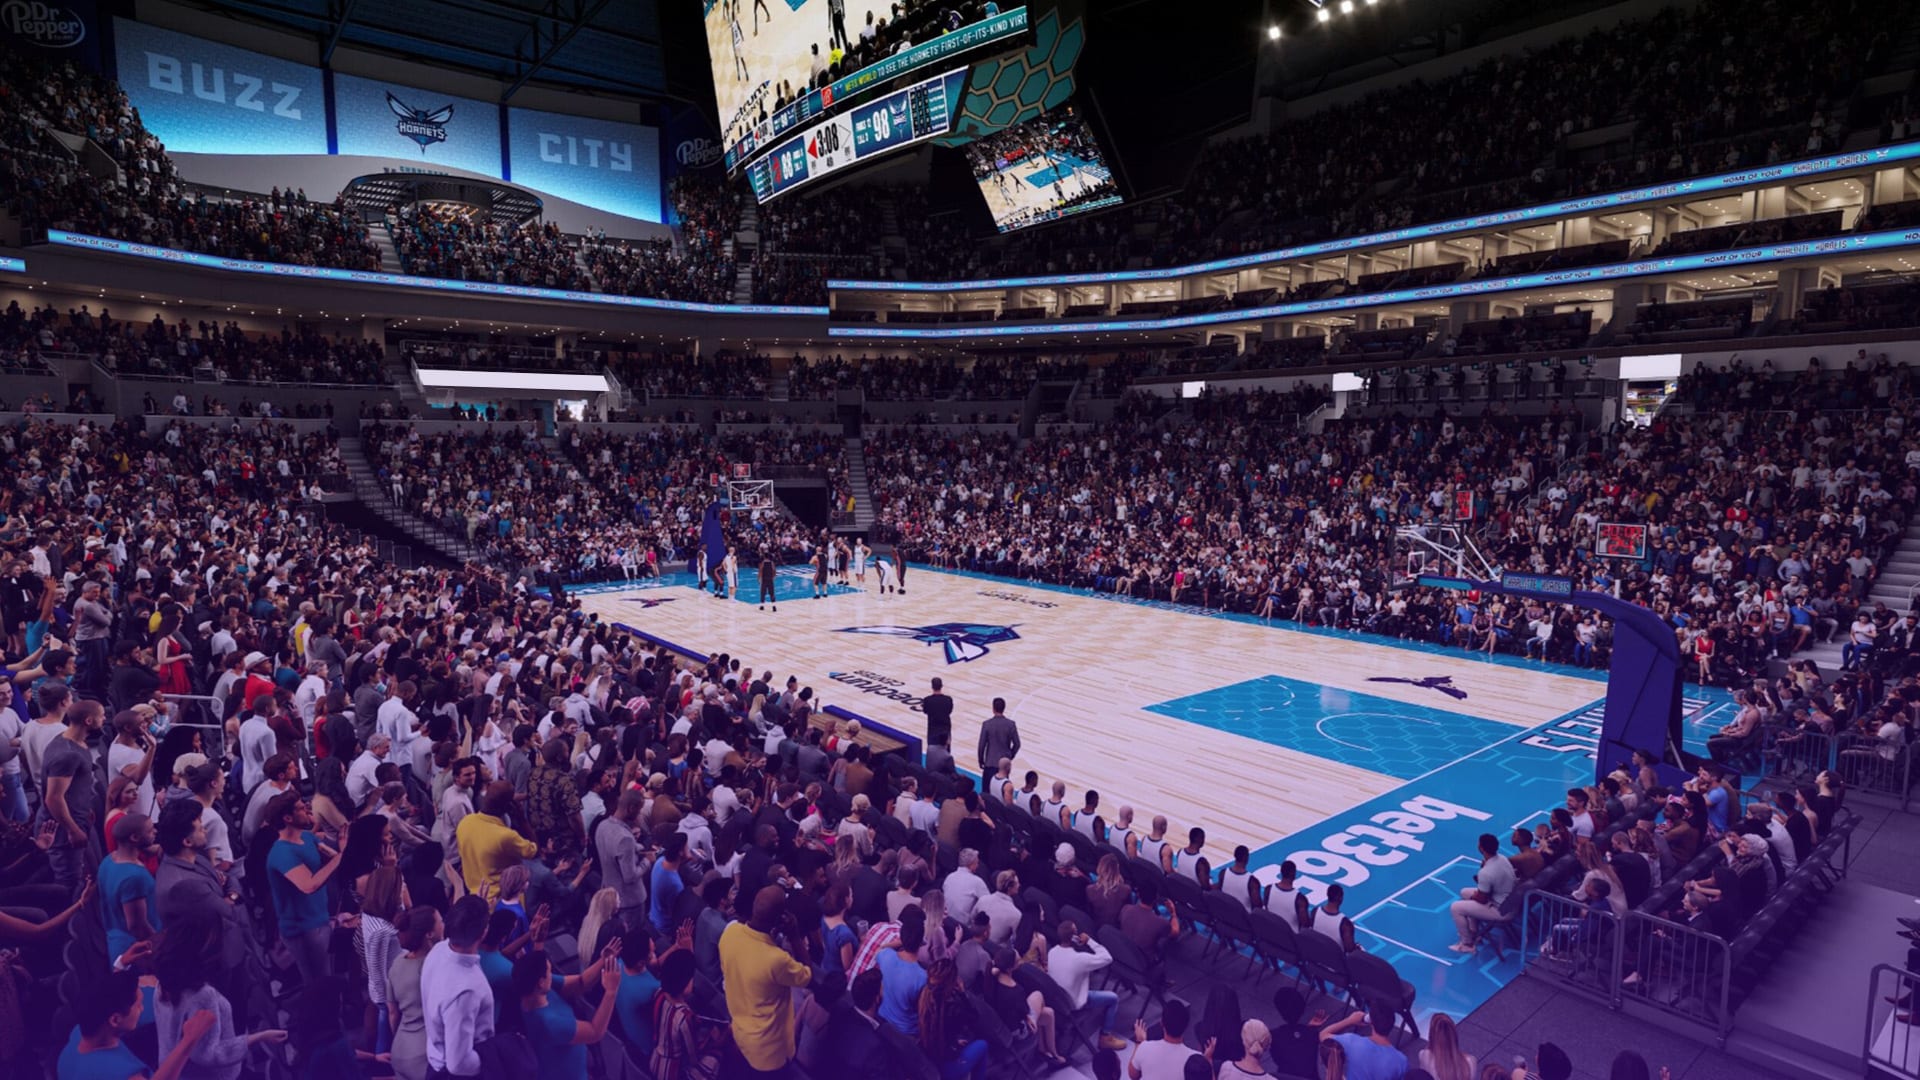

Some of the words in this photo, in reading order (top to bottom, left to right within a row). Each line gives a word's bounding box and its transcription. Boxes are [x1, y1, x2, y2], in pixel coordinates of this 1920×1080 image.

[31, 1, 60, 20] Dr
[1, 1, 79, 40] Pepper
[886, 62, 897, 74] SEE
[898, 56, 910, 70] THE
[144, 51, 303, 121] BUZZ
[400, 122, 445, 140] HORNETS
[872, 108, 890, 142] 98
[693, 137, 712, 152] Dr
[817, 122, 839, 158] 3:08
[538, 132, 633, 172] CITY
[1722, 174, 1746, 185] HOME
[1748, 173, 1758, 181] OF
[1761, 168, 1783, 178] YOUR
[1904, 232, 1920, 240] HO
[1704, 255, 1726, 264] HOME
[1742, 251, 1762, 260] YOUR
[1252, 794, 1494, 908] bet365
